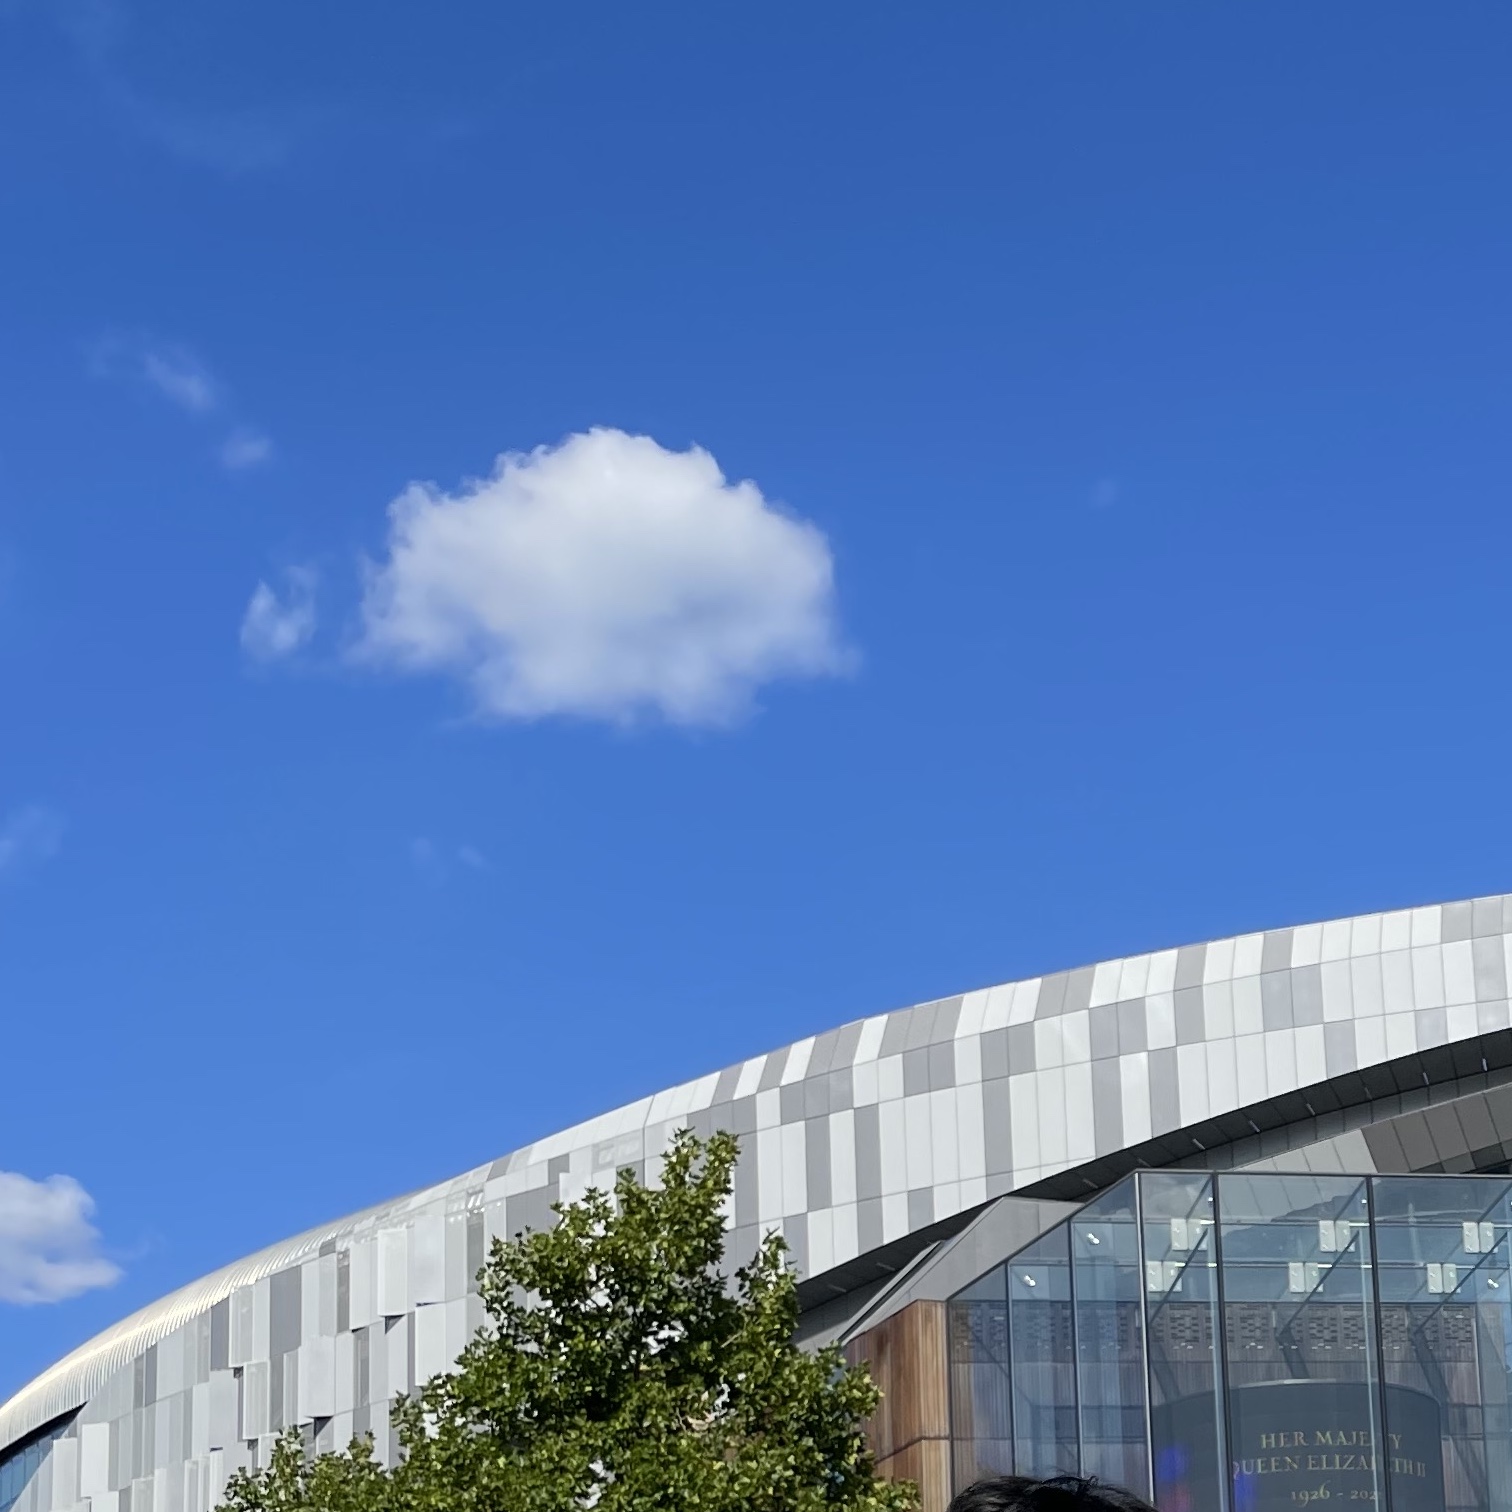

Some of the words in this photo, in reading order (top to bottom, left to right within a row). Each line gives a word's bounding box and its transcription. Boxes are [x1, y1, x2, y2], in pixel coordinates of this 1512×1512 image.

[1261, 1431, 1309, 1449] HER
[1315, 1431, 1403, 1449] MAJEY
[1307, 1454, 1414, 1475] ELIZATH
[1291, 1479, 1331, 1508] 1926
[1351, 1490, 1382, 1500] 202
